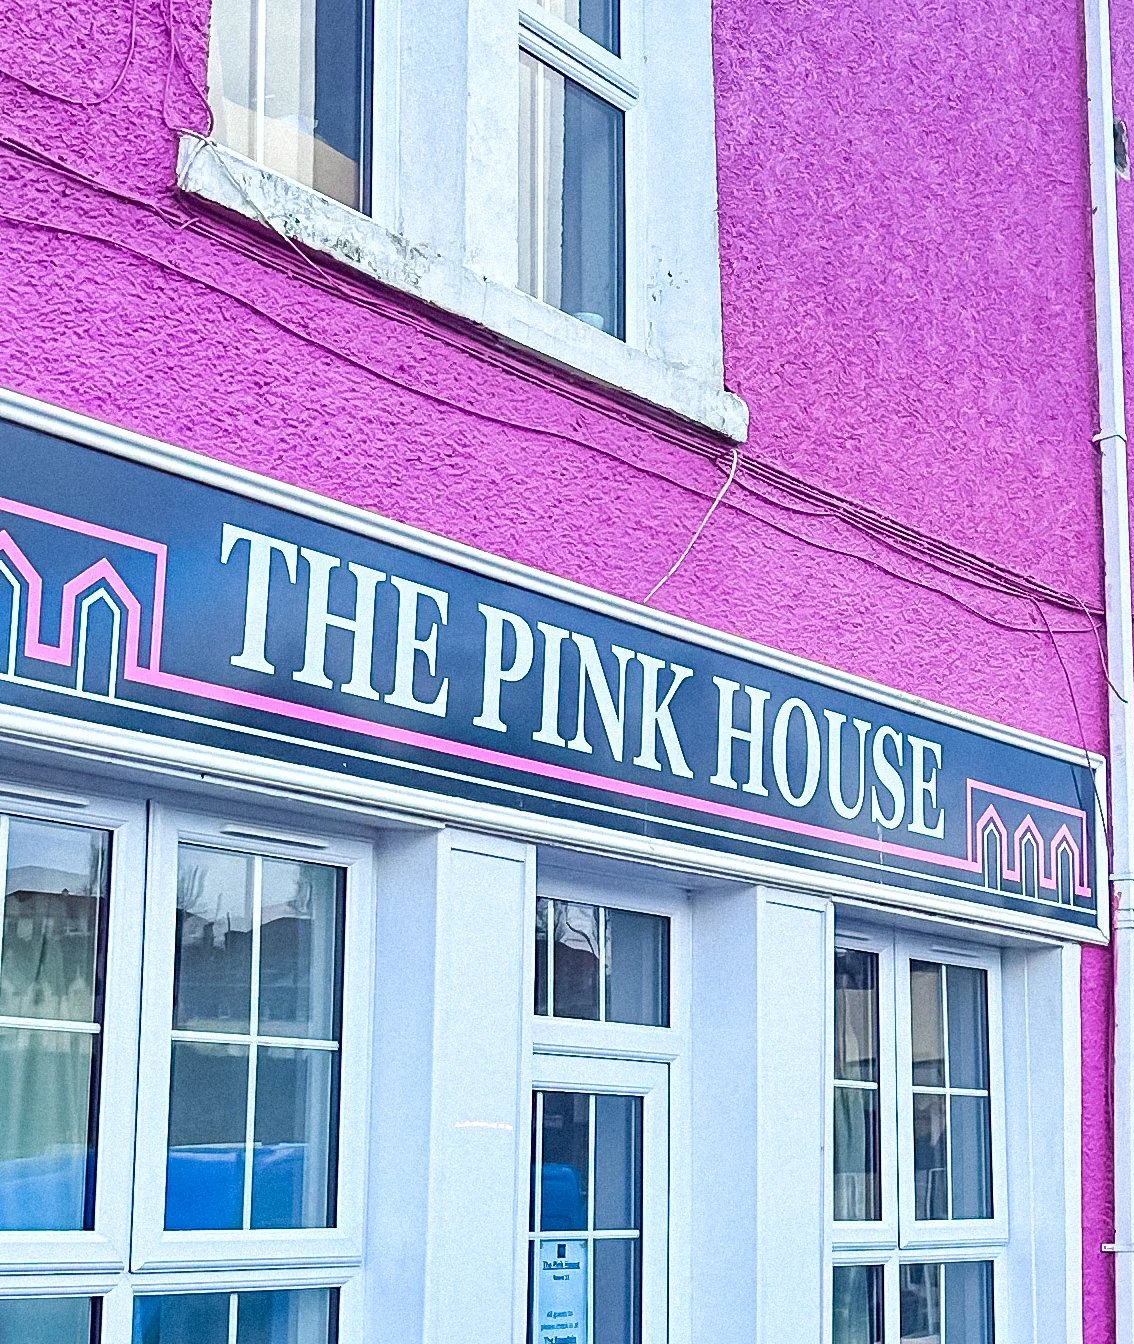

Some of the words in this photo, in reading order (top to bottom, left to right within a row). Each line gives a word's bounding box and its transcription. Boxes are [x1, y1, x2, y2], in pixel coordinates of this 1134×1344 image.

[221, 523, 448, 718] THE
[472, 602, 693, 780] PINK
[710, 675, 945, 839] HOUSE
